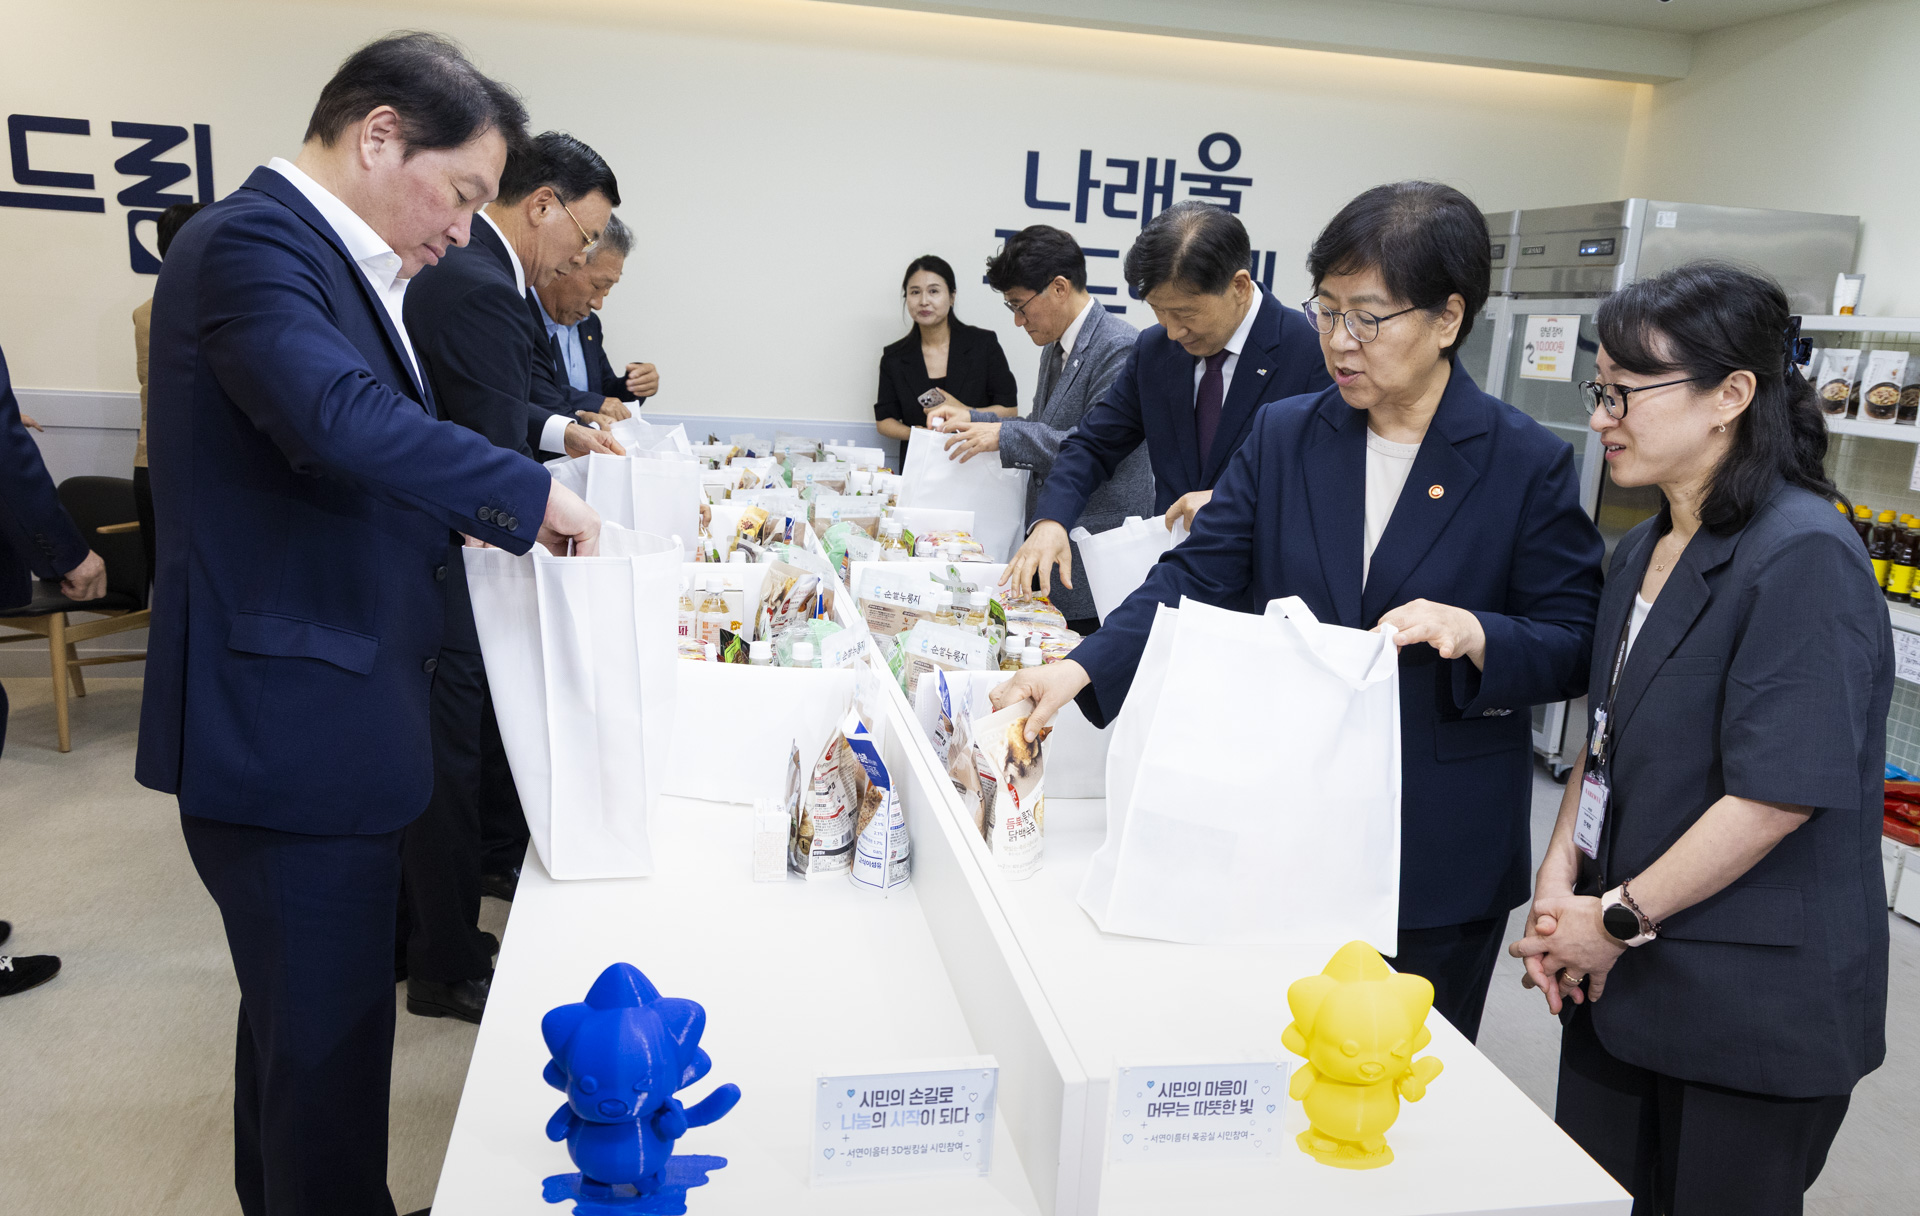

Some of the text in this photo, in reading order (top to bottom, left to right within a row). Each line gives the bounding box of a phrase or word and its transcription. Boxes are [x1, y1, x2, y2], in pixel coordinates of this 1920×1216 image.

[1024, 131, 1253, 229] 나래울
[1535, 341, 1566, 353] 10,000원
[859, 1086, 954, 1108] 시민의 손길로
[1158, 1079, 1248, 1098] 시민의 마음이
[1147, 1098, 1254, 1118] 머무는 따뜻한 빛
[840, 1106, 970, 1131] 나눔의 시작이 되다
[1217, 1130, 1249, 1141] 시민참여
[930, 1141, 963, 1154] 시민참여
